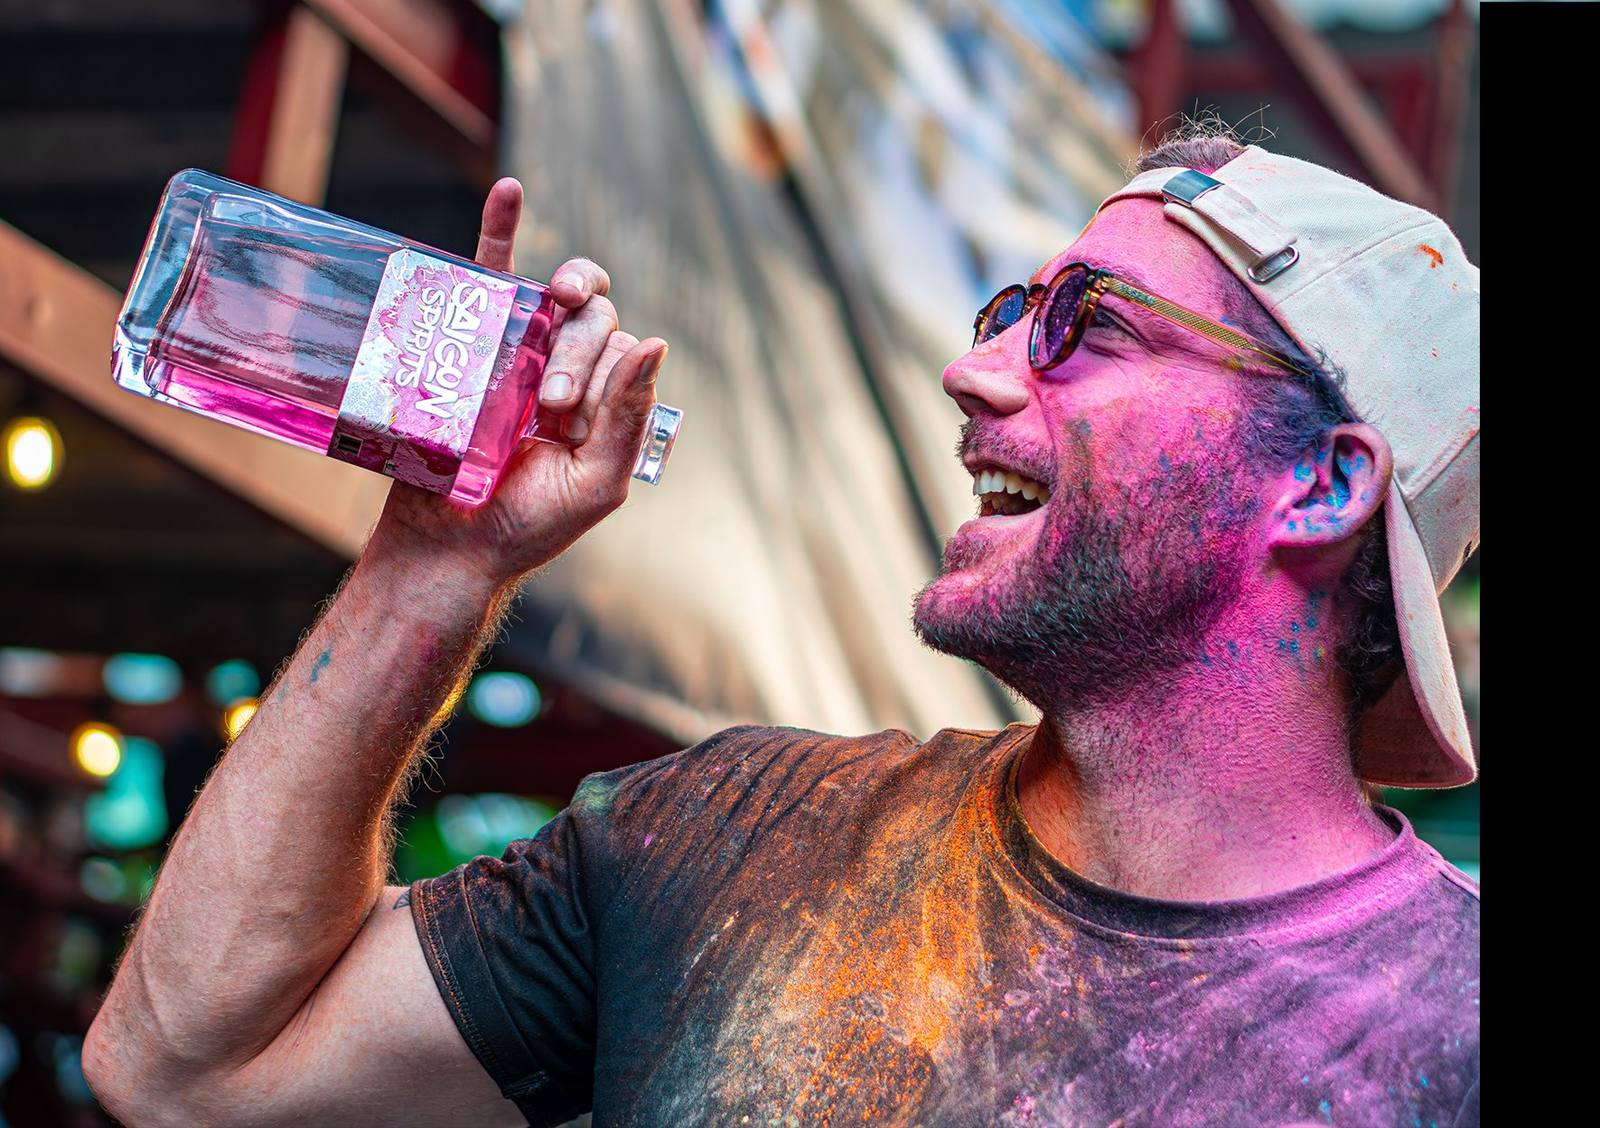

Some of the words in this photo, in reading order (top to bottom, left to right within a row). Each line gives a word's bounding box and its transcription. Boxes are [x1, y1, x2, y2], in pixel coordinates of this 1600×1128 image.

[383, 290, 404, 331] PINK
[394, 287, 445, 388] SPIRITS
[413, 282, 488, 418] SAIGON
